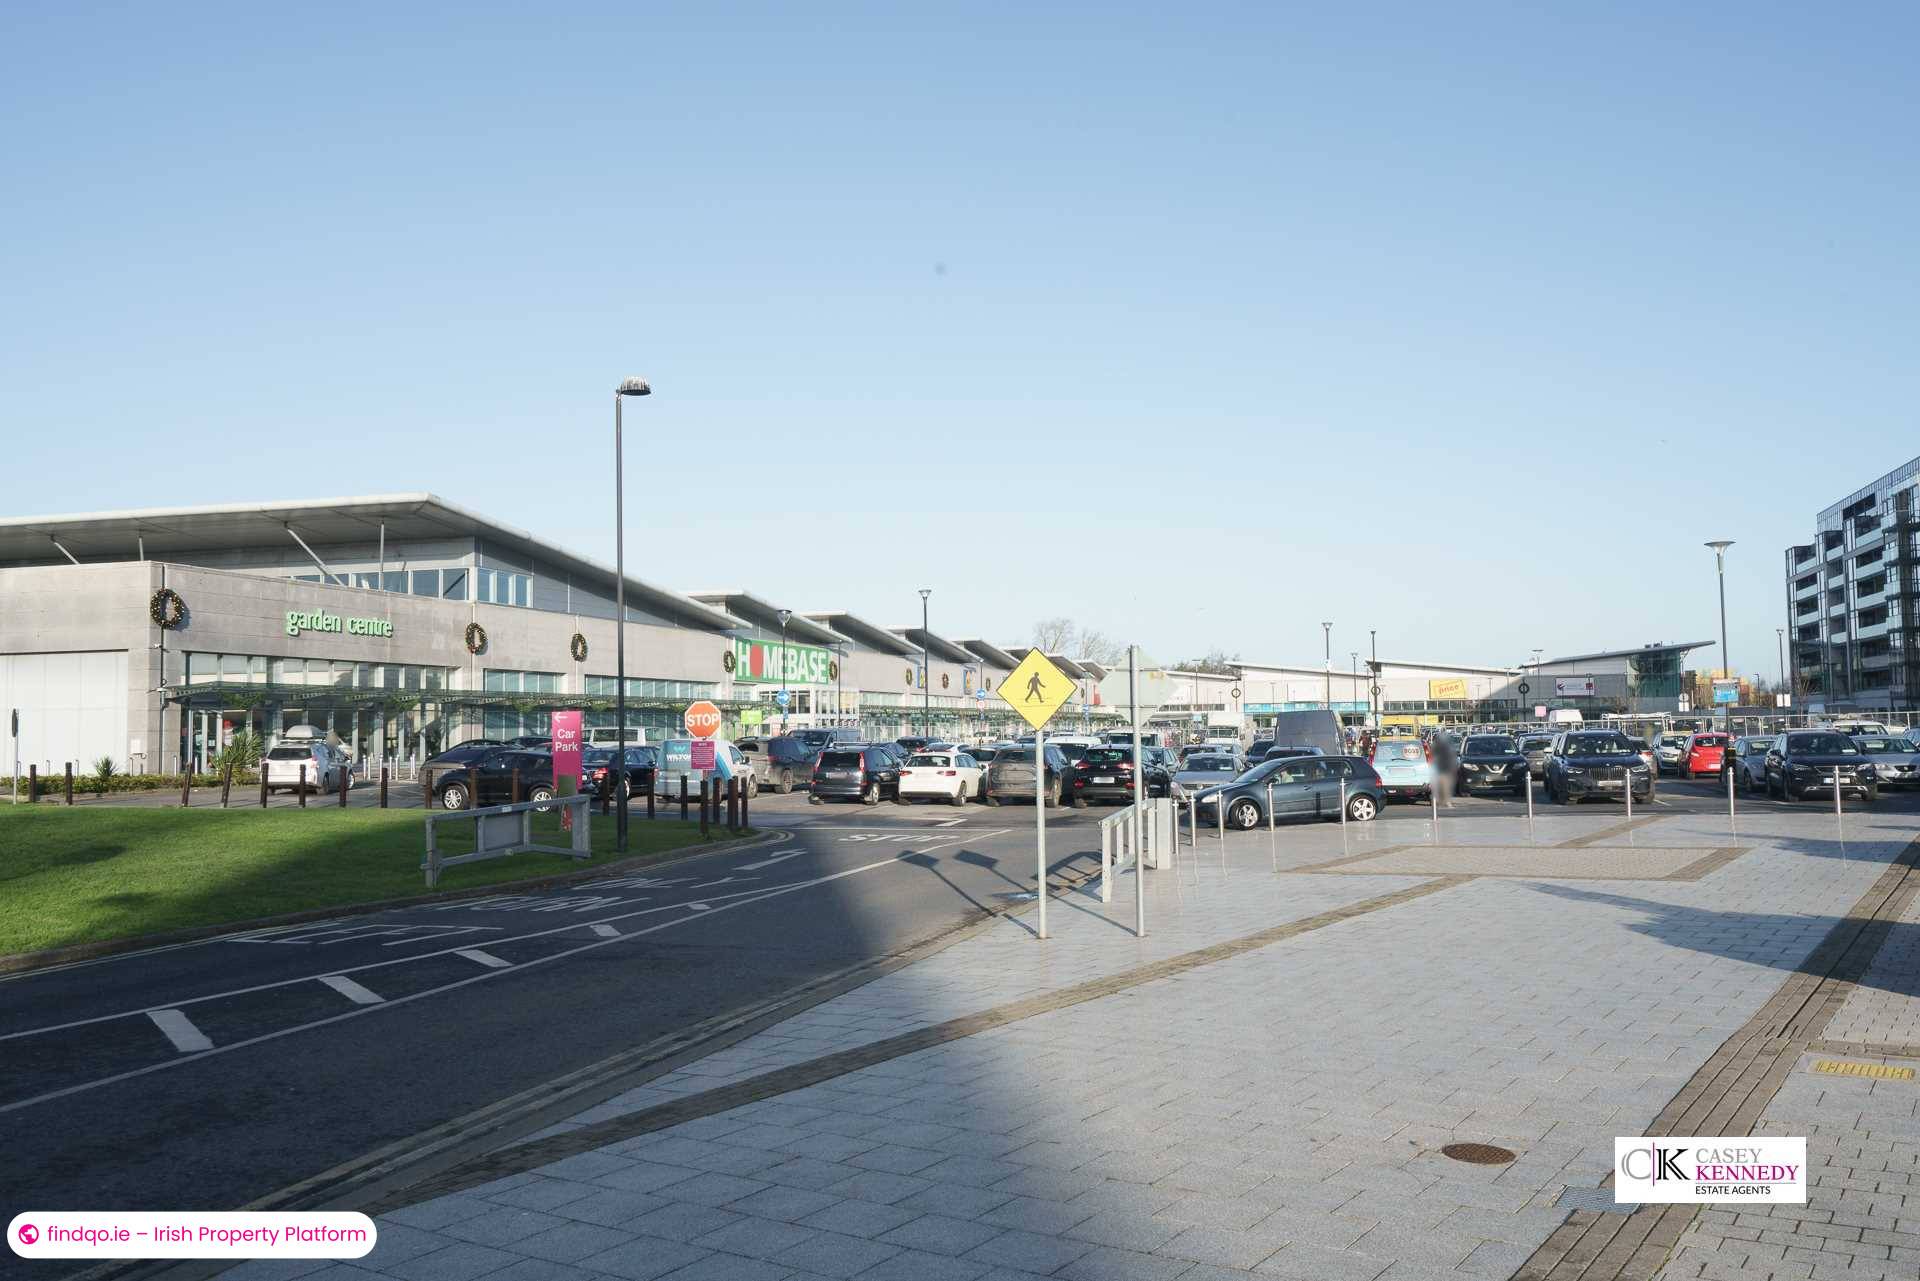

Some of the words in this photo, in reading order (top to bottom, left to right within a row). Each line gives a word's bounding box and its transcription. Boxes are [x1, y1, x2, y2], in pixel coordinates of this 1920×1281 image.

[287, 608, 342, 636] garden
[347, 616, 393, 637] centre
[737, 640, 828, 683] HOMEBASE
[687, 713, 719, 727] STOP
[557, 728, 576, 739] Car
[555, 741, 579, 752] Park
[225, 922, 504, 946] LEFT
